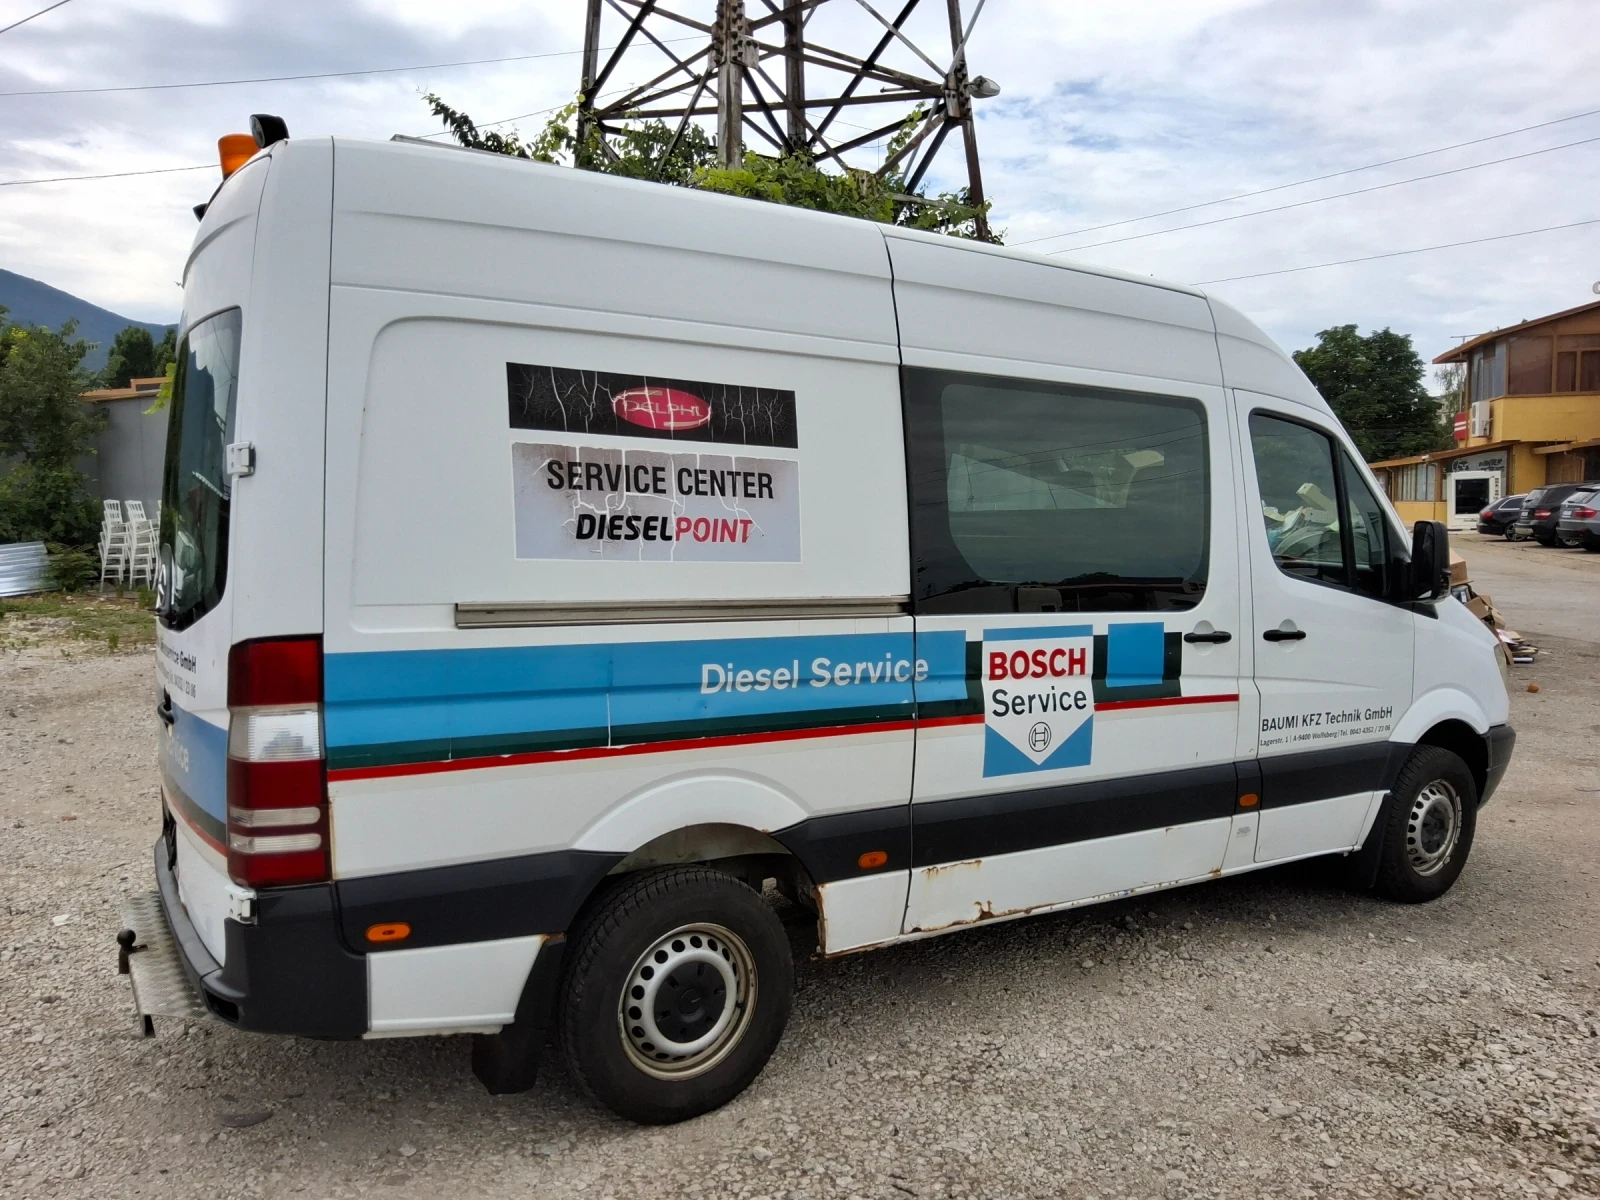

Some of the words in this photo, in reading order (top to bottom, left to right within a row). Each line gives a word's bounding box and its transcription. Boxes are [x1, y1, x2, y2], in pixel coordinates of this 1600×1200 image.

[623, 400, 702, 417] DELPHI
[547, 459, 667, 494] SERVICE
[677, 467, 774, 499] CENTER
[575, 513, 754, 544] DIESELPOINT
[700, 659, 799, 694] Diesel
[809, 652, 929, 688] Service
[989, 647, 1087, 681] BOSCH
[992, 685, 1087, 717] Service
[1261, 715, 1299, 732] BAUMI
[1302, 713, 1322, 727] KFZ
[1325, 708, 1361, 725] Technik
[1364, 705, 1393, 721] GmbH
[1260, 737, 1284, 747] Lagerstr.
[1312, 731, 1338, 739] Wolfsberg
